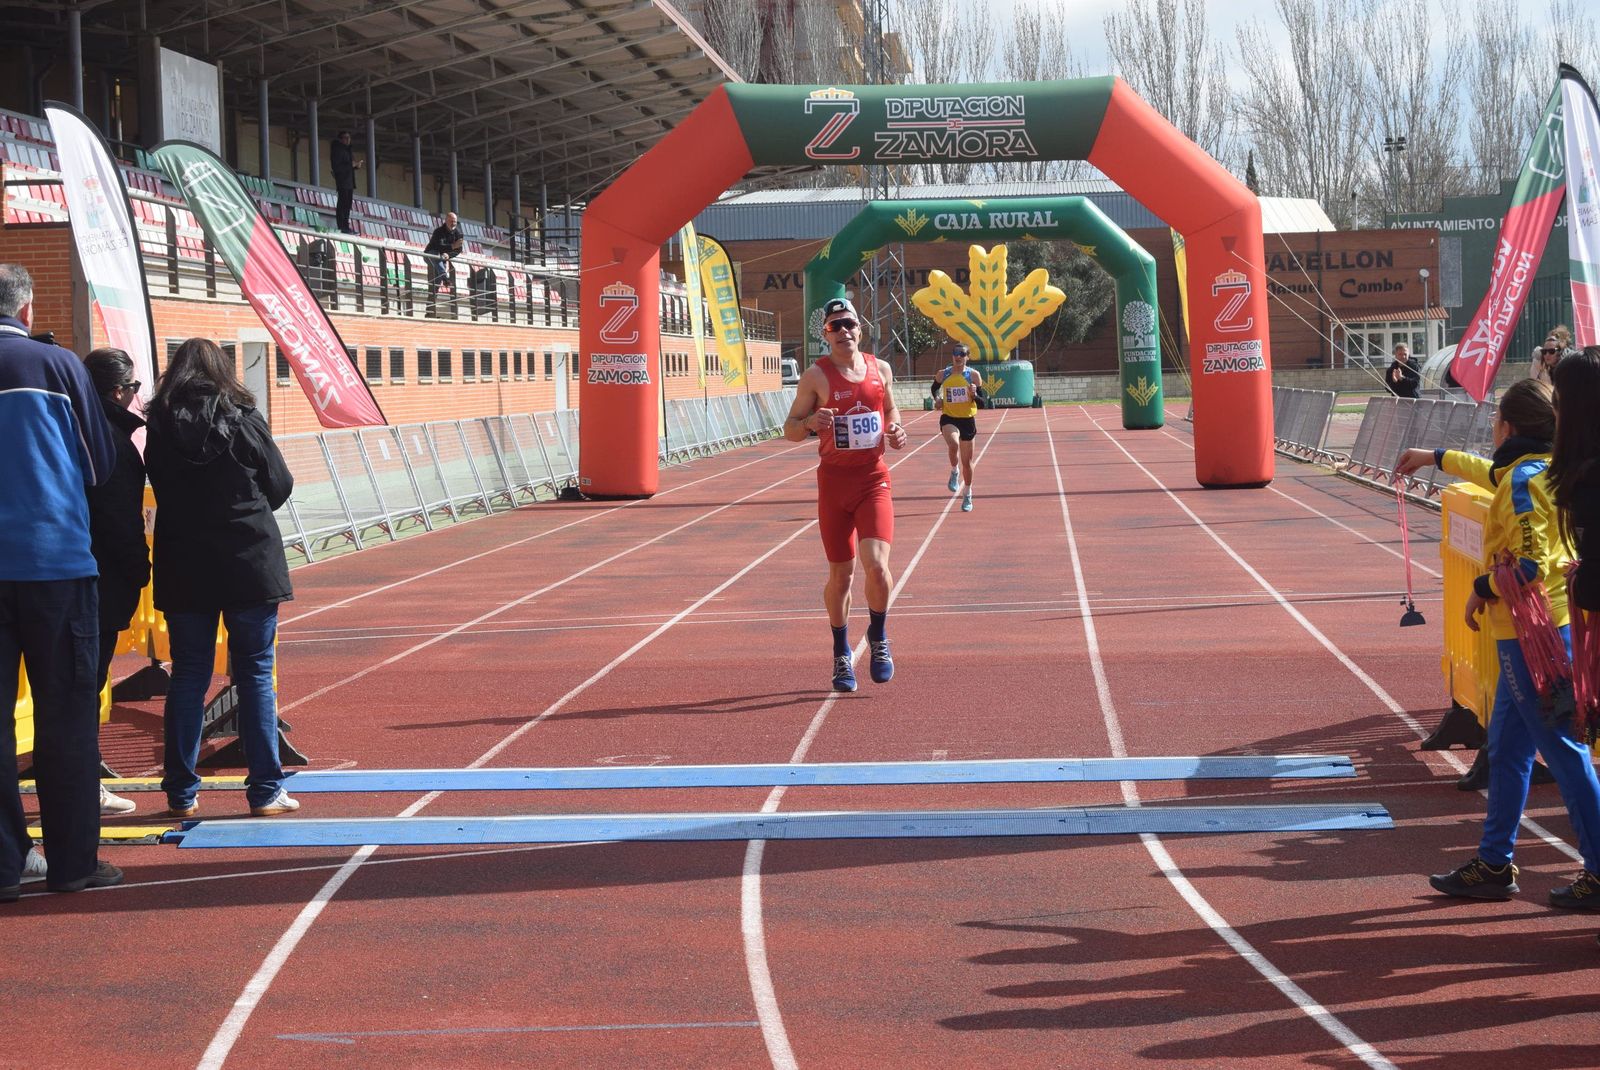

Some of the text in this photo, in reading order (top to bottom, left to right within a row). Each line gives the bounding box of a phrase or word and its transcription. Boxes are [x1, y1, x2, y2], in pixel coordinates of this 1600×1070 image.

[874, 129, 1038, 159] ZAMORA
[934, 210, 1059, 231] CAJA RURAL
[1203, 356, 1266, 374] ZAMORA
[588, 369, 650, 384] ZAMORA
[852, 416, 879, 435] 596
